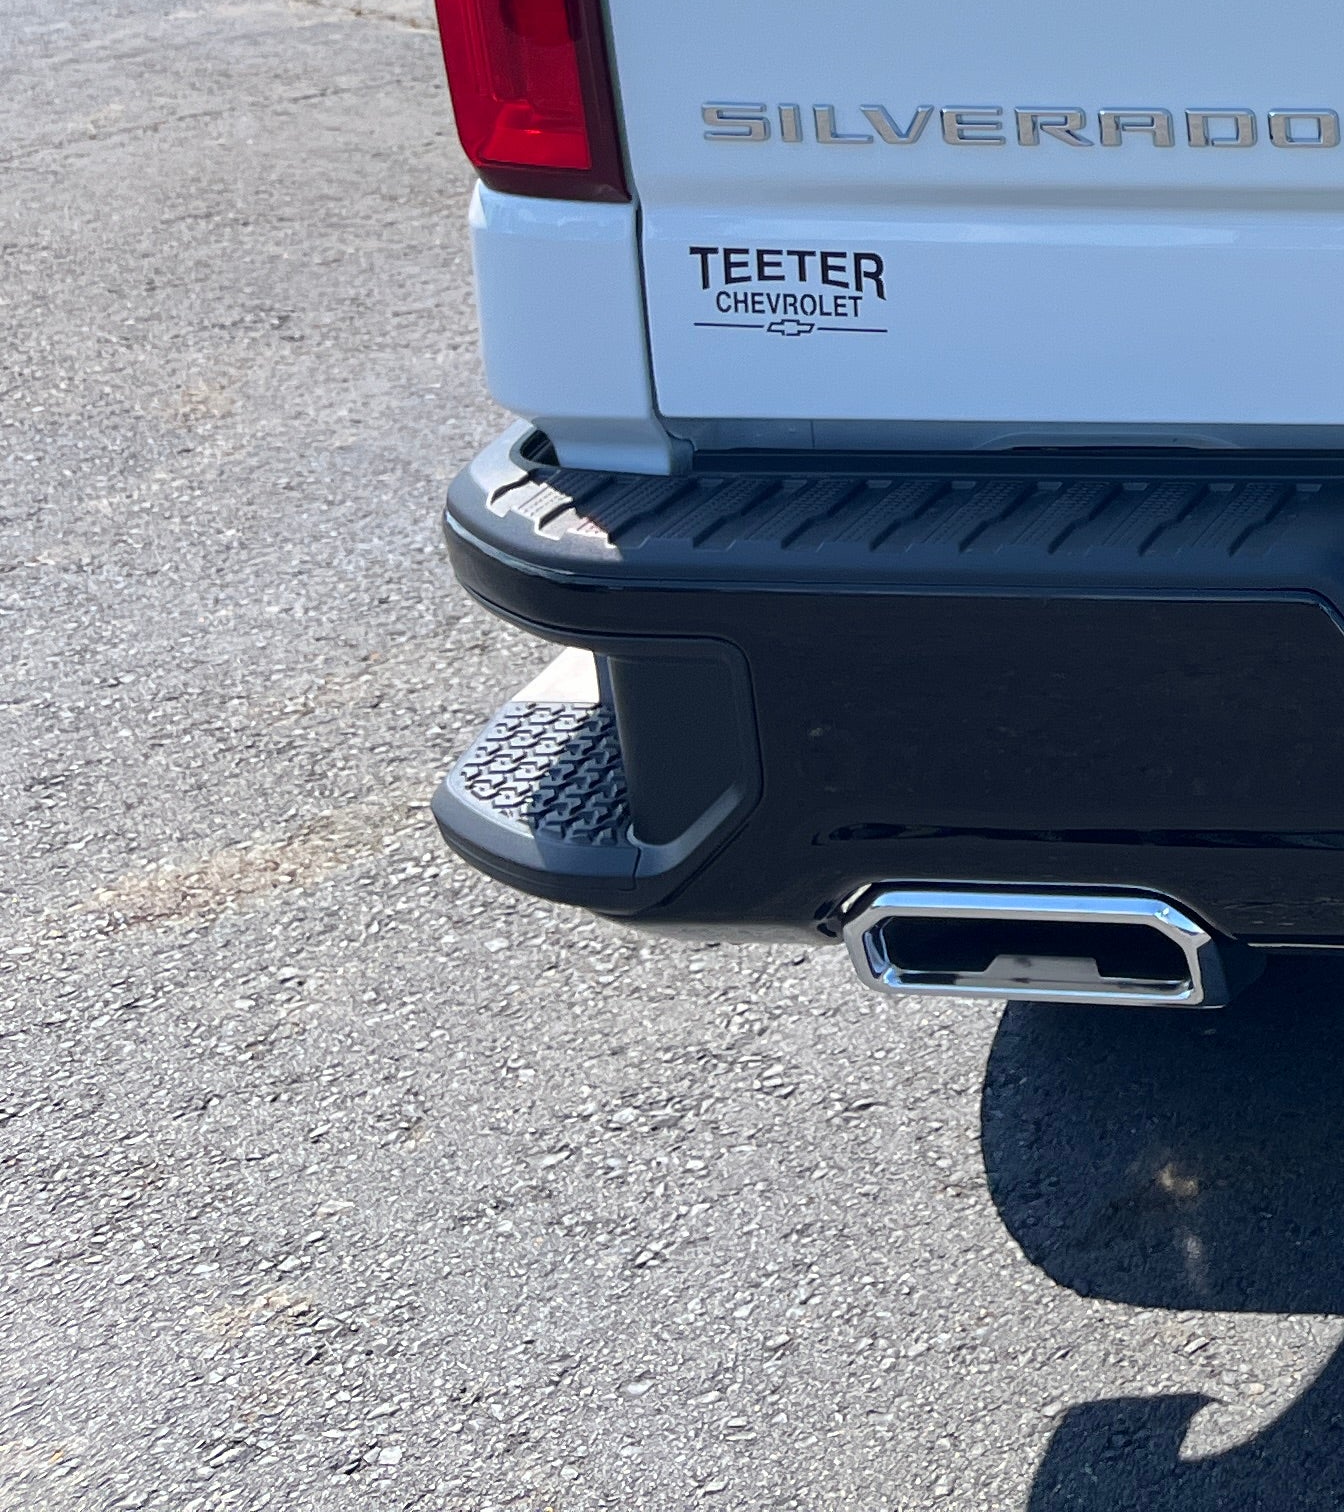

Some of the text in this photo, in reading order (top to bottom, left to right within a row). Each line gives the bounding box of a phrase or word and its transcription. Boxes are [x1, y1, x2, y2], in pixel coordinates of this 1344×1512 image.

[701, 102, 1342, 148] SILVERADO
[689, 246, 887, 301] TEETER
[715, 290, 863, 318] CHEVROLET
